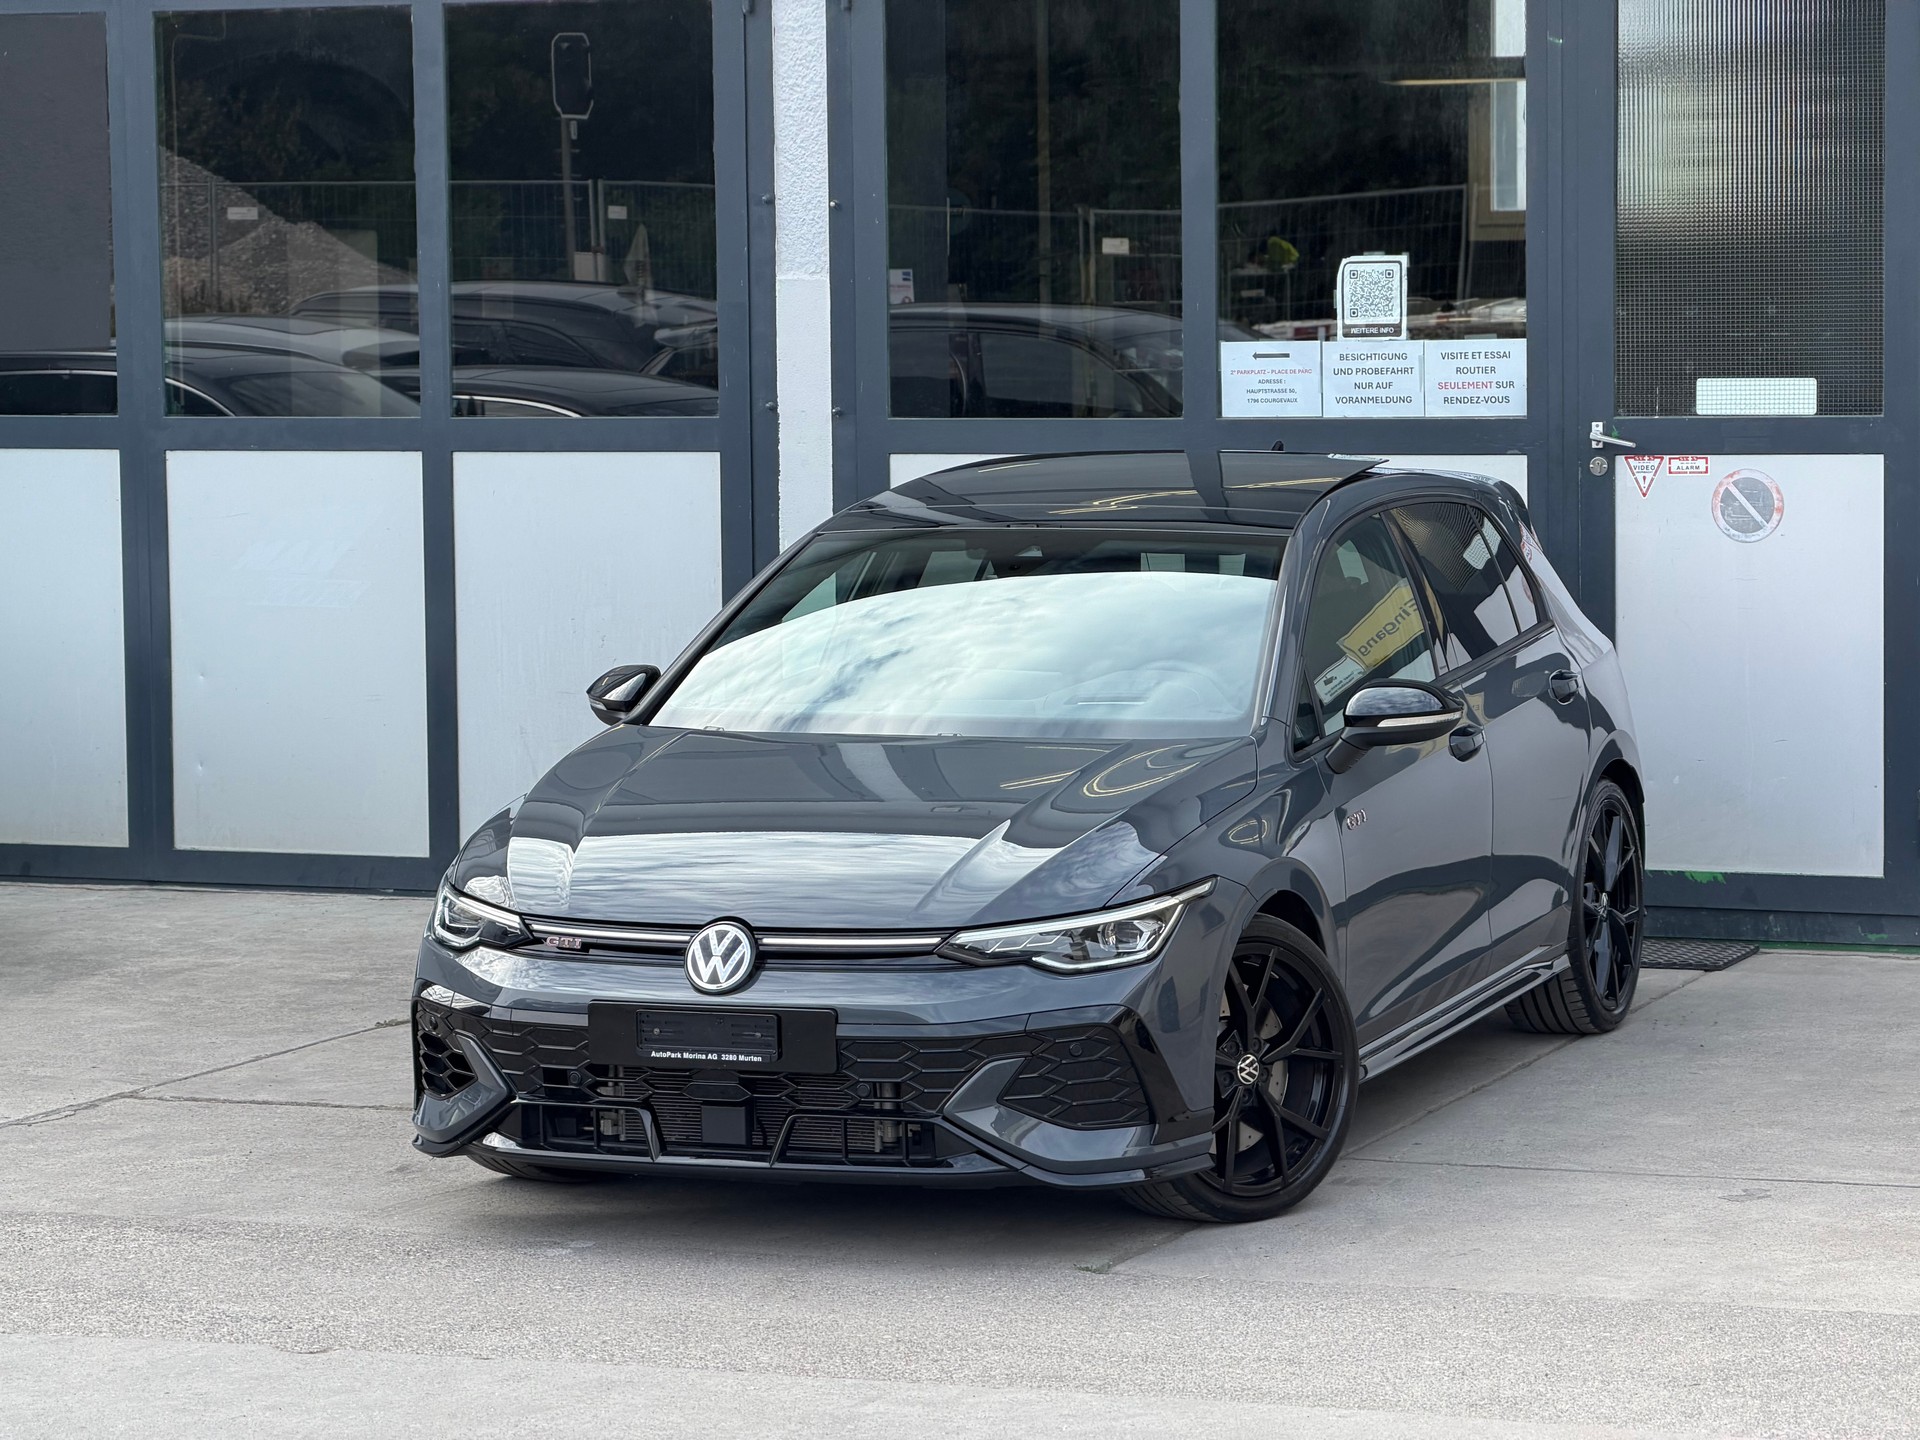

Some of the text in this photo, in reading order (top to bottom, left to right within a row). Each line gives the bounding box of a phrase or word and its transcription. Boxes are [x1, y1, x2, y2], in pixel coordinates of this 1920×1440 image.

[1339, 352, 1408, 361] BESICHTIGUNG
[1440, 350, 1511, 360] VISITE ET ESSAI
[1333, 366, 1414, 376] UND PROBEFAHRT
[1455, 366, 1497, 375] ROUTIER
[1375, 381, 1393, 389] AUF
[1437, 380, 1515, 390] SEULEMENT SUR
[1335, 396, 1413, 405] VORANMELDUNG
[1443, 395, 1511, 405] RENDEZ-VOUS
[546, 936, 582, 949] GTI
[690, 924, 750, 985] VW
[650, 1050, 682, 1059] AutoPark
[683, 1052, 706, 1060] Morina
[721, 1053, 737, 1061] 3280
[738, 1054, 762, 1062] Murten
